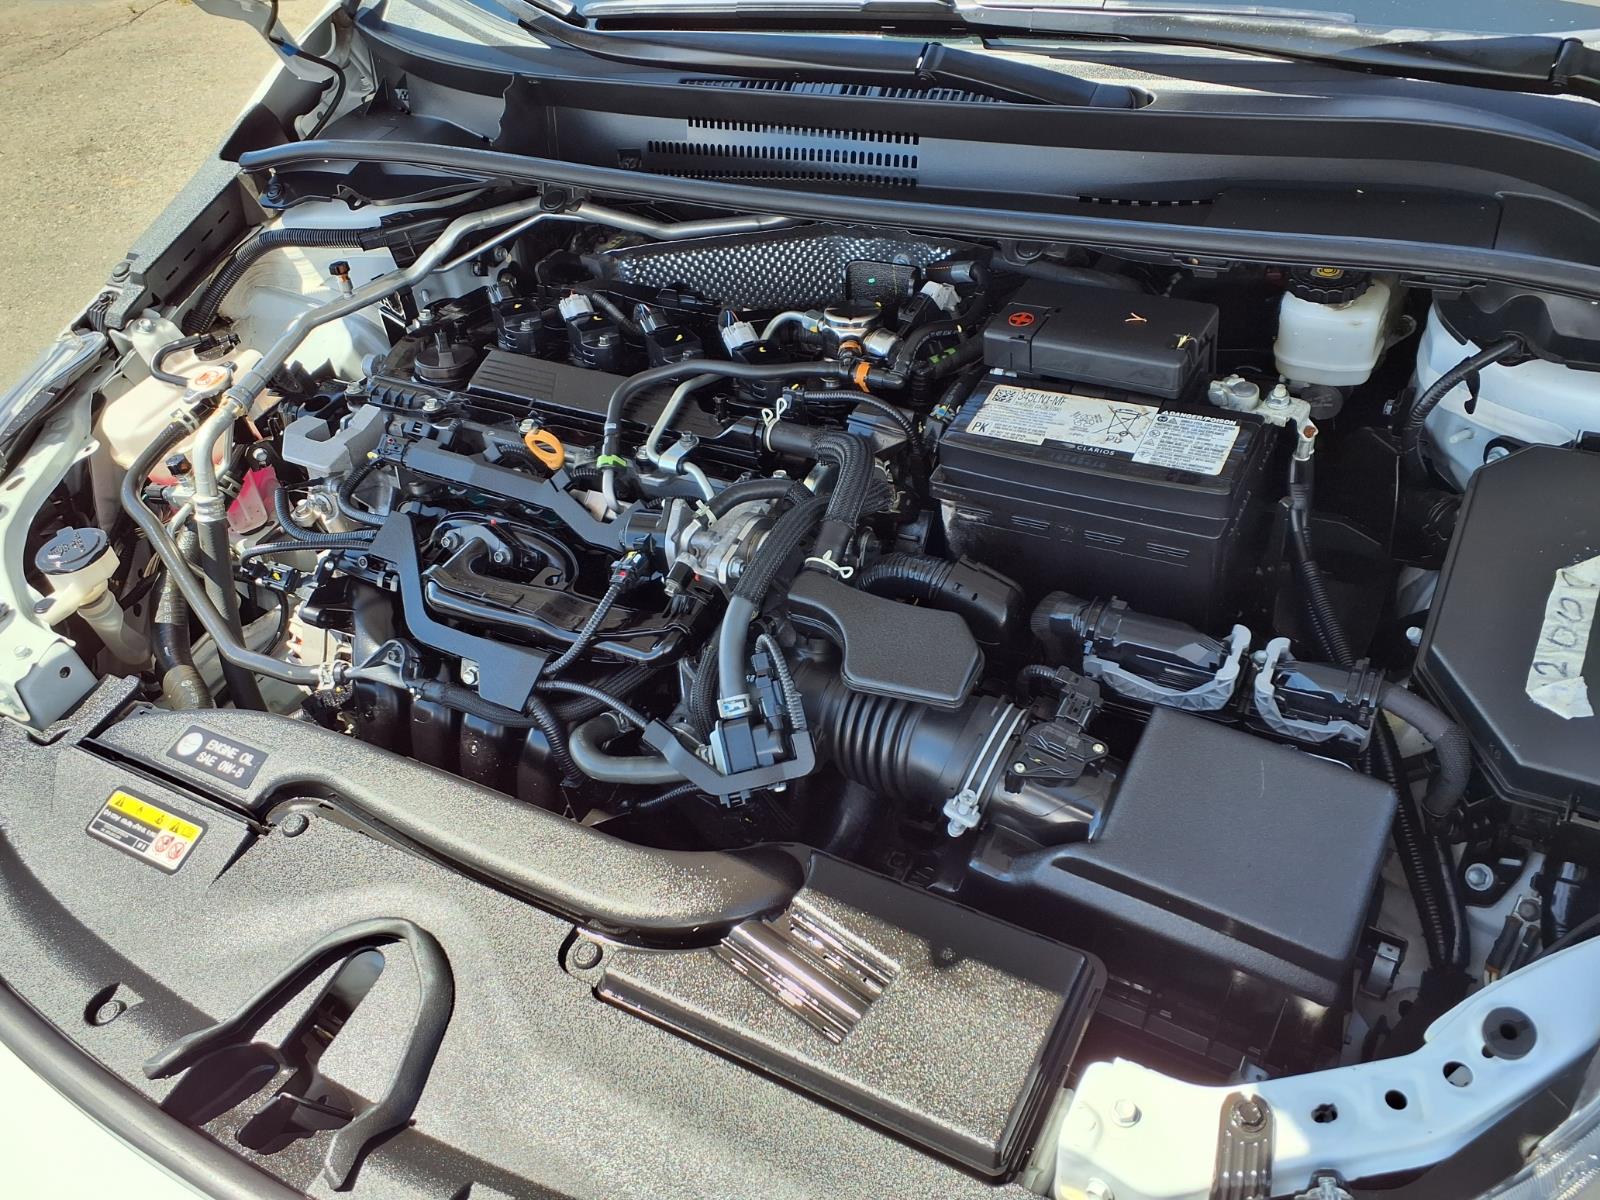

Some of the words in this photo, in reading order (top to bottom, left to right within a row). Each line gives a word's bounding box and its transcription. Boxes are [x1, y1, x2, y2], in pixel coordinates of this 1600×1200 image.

[1168, 410, 1237, 426] DANGER/POISON
[971, 421, 990, 433] PK
[1076, 444, 1116, 457] CLARIOS
[205, 739, 240, 760] ENGINE
[196, 750, 218, 767] SAE
